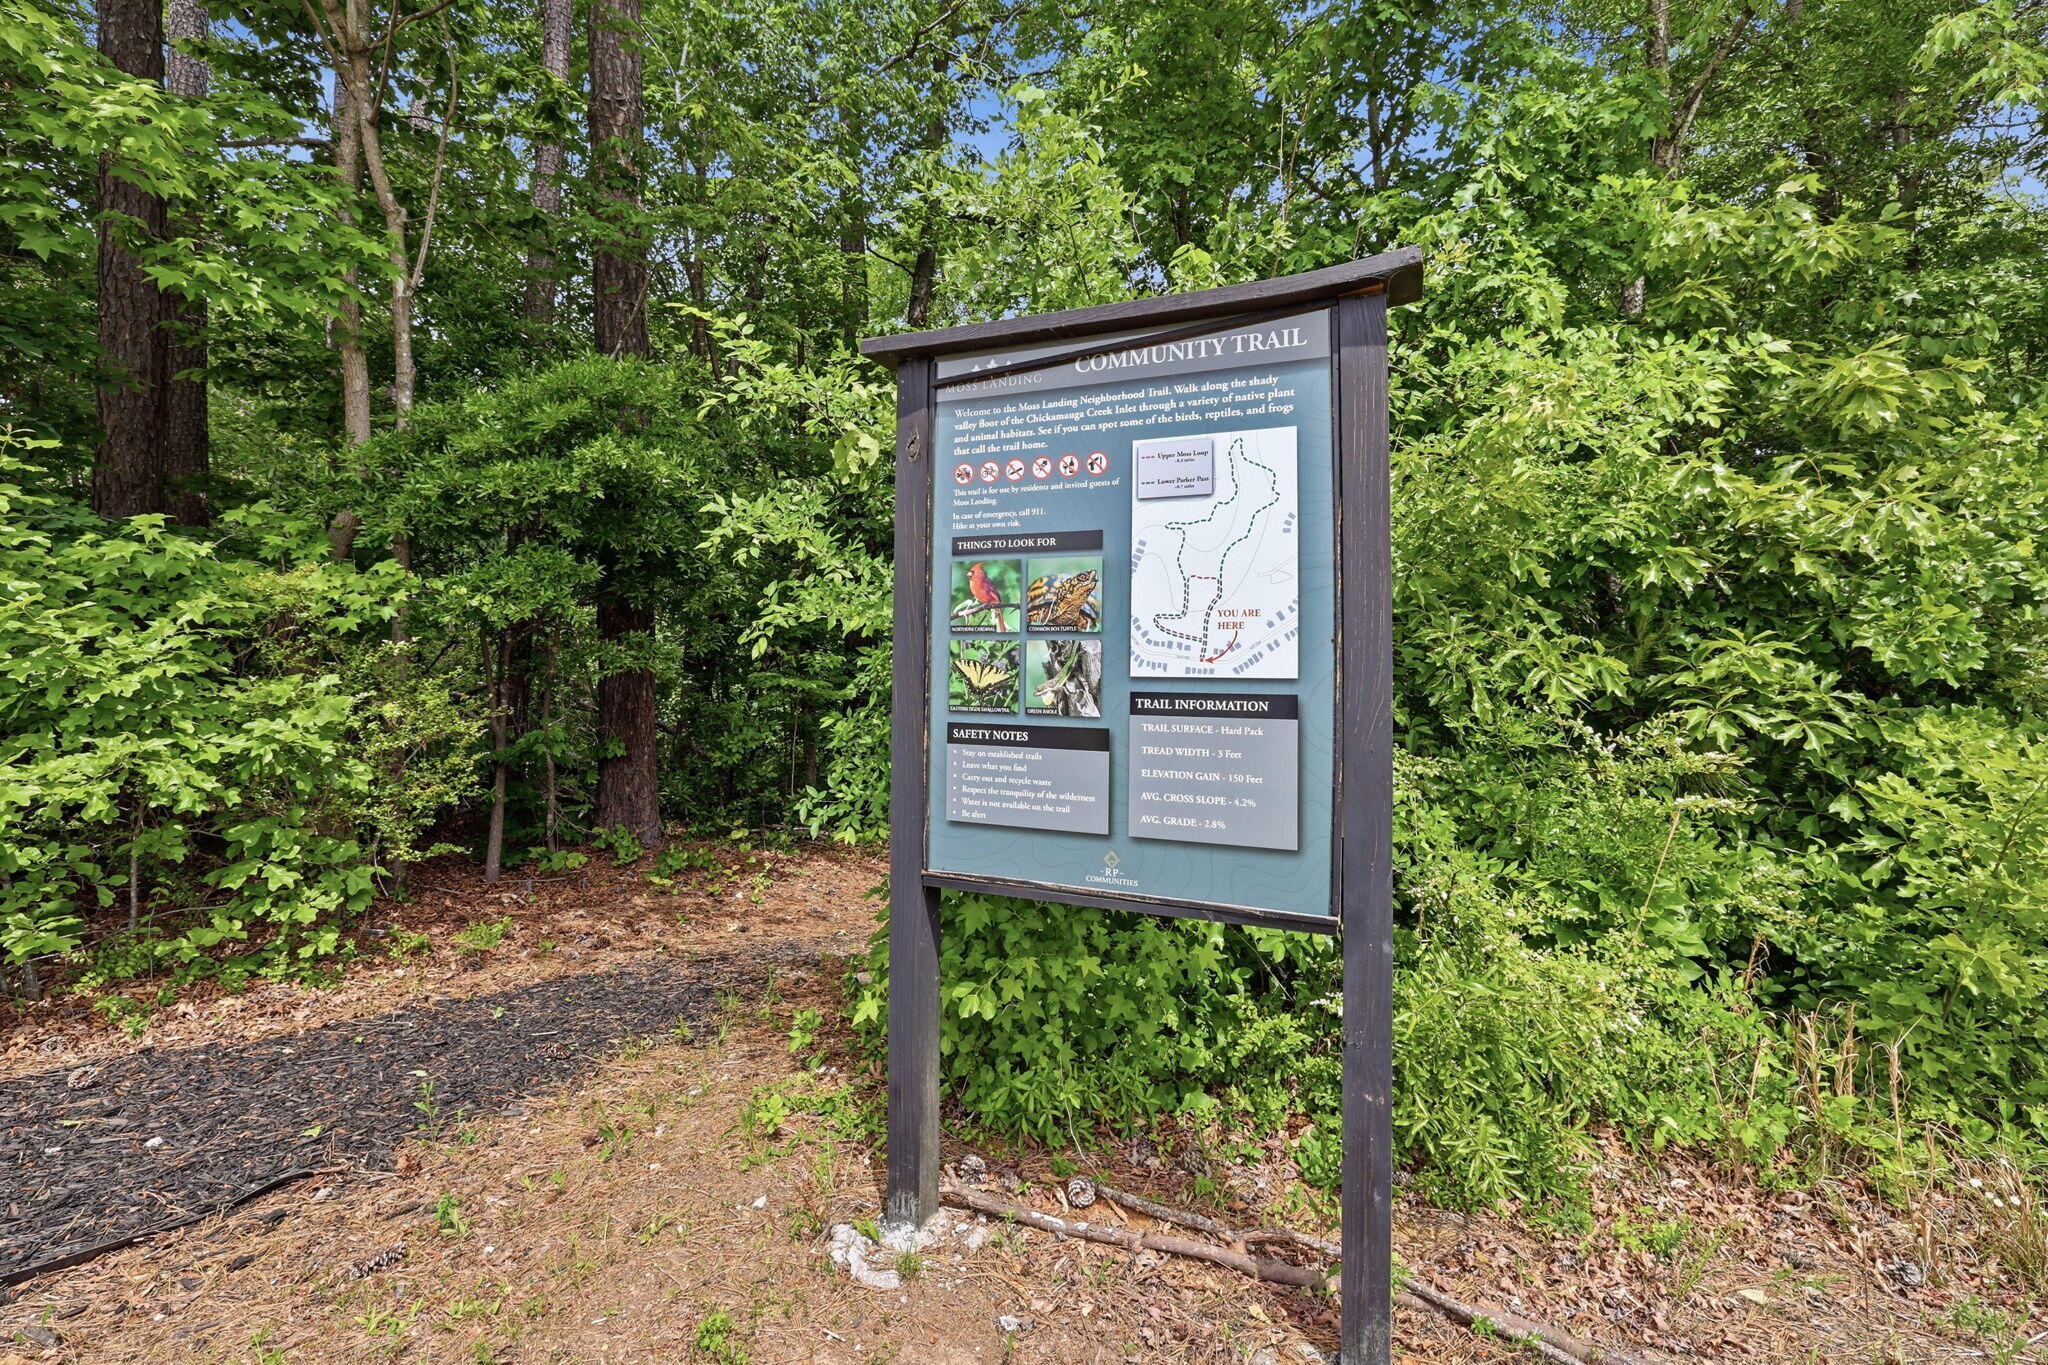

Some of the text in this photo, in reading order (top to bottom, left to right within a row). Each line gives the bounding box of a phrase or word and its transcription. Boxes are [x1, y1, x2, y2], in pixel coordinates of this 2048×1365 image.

[1075, 328, 1307, 372] COMMUNITY TRAIL
[946, 374, 1042, 394] MOSS LANDING
[955, 408, 991, 417] Welcome
[1004, 404, 1016, 412] the
[1019, 402, 1041, 410] Moss
[1042, 397, 1078, 408] Landing
[1080, 389, 1145, 405] Neighborhood
[1149, 386, 1172, 396] Trail.
[1174, 383, 1199, 393] Walk
[1201, 382, 1228, 391] along
[1232, 379, 1247, 387] the
[1250, 375, 1280, 385] shady
[955, 421, 977, 431] valley
[979, 419, 998, 427] floor
[1000, 417, 1010, 425] of
[1012, 416, 1024, 424] the
[1027, 411, 1084, 422] Chickamauga
[1087, 406, 1113, 416] Creek
[1116, 404, 1136, 413] Inlet
[1139, 399, 1177, 411] through
[1187, 396, 1220, 406] variety
[1222, 393, 1233, 402] of
[1236, 391, 1265, 401] native
[1268, 388, 1296, 400] plant
[954, 434, 969, 443] and
[971, 431, 999, 441] animal
[1001, 429, 1036, 438] habitats.
[1038, 426, 1052, 435] See
[1062, 426, 1078, 435] you
[1099, 421, 1118, 431] spot
[1120, 419, 1143, 427] some
[1146, 415, 1157, 424] of
[1158, 415, 1173, 423] the
[1176, 412, 1202, 421] birds,
[1206, 408, 1244, 420] reptiles,
[1247, 405, 1265, 414] and
[1268, 404, 1294, 414] frogs
[954, 441, 1048, 455] that call the trail home.
[1012, 485, 1019, 495] by
[1021, 484, 1049, 492] residents
[1065, 480, 1087, 489] invited
[1090, 480, 1110, 489] guests
[971, 497, 998, 506] Landing.
[983, 511, 1018, 519] emergency,
[1019, 508, 1030, 516] call
[953, 522, 968, 530] Hike
[977, 523, 991, 531] your
[958, 538, 1056, 550] THINGS TO LOOK FOR
[1218, 622, 1244, 630] HERE
[1136, 699, 1269, 711] TRAIL INFORMATION
[953, 729, 1029, 741] SAFETY NOTES
[1142, 724, 1169, 732] TRAIL
[1172, 725, 1214, 734] SURFACE
[1222, 726, 1242, 735] Hard
[1245, 728, 1263, 736] Pack
[962, 748, 976, 758] Stay
[988, 751, 1023, 759] established
[1142, 747, 1173, 755] TREAD
[1175, 748, 1209, 757] WIDTH
[1226, 750, 1242, 759] Feet
[962, 761, 980, 769] Leave
[1014, 764, 1027, 772] find
[962, 773, 980, 784] Carry
[1009, 777, 1031, 787] recycle
[1142, 770, 1193, 779] ELEVATION
[1196, 773, 1220, 781] GAIN
[1229, 775, 1244, 783] 150
[1247, 775, 1263, 784] Feet
[962, 785, 987, 796] Respect
[1000, 789, 1036, 800] tranquility
[1059, 793, 1096, 802] wilderness
[962, 797, 981, 806] Water
[1003, 801, 1031, 810] available
[1141, 793, 1162, 801] AVG.
[1164, 794, 1194, 803] CROSS
[1196, 796, 1226, 805] SLOPE
[1235, 799, 1256, 807] 4.2%
[972, 811, 986, 819] alert
[1141, 816, 1161, 824] AVG.
[1164, 817, 1197, 826] GRADE
[1205, 821, 1226, 829] 2.8%
[1086, 875, 1139, 887] COMMUNITIES
